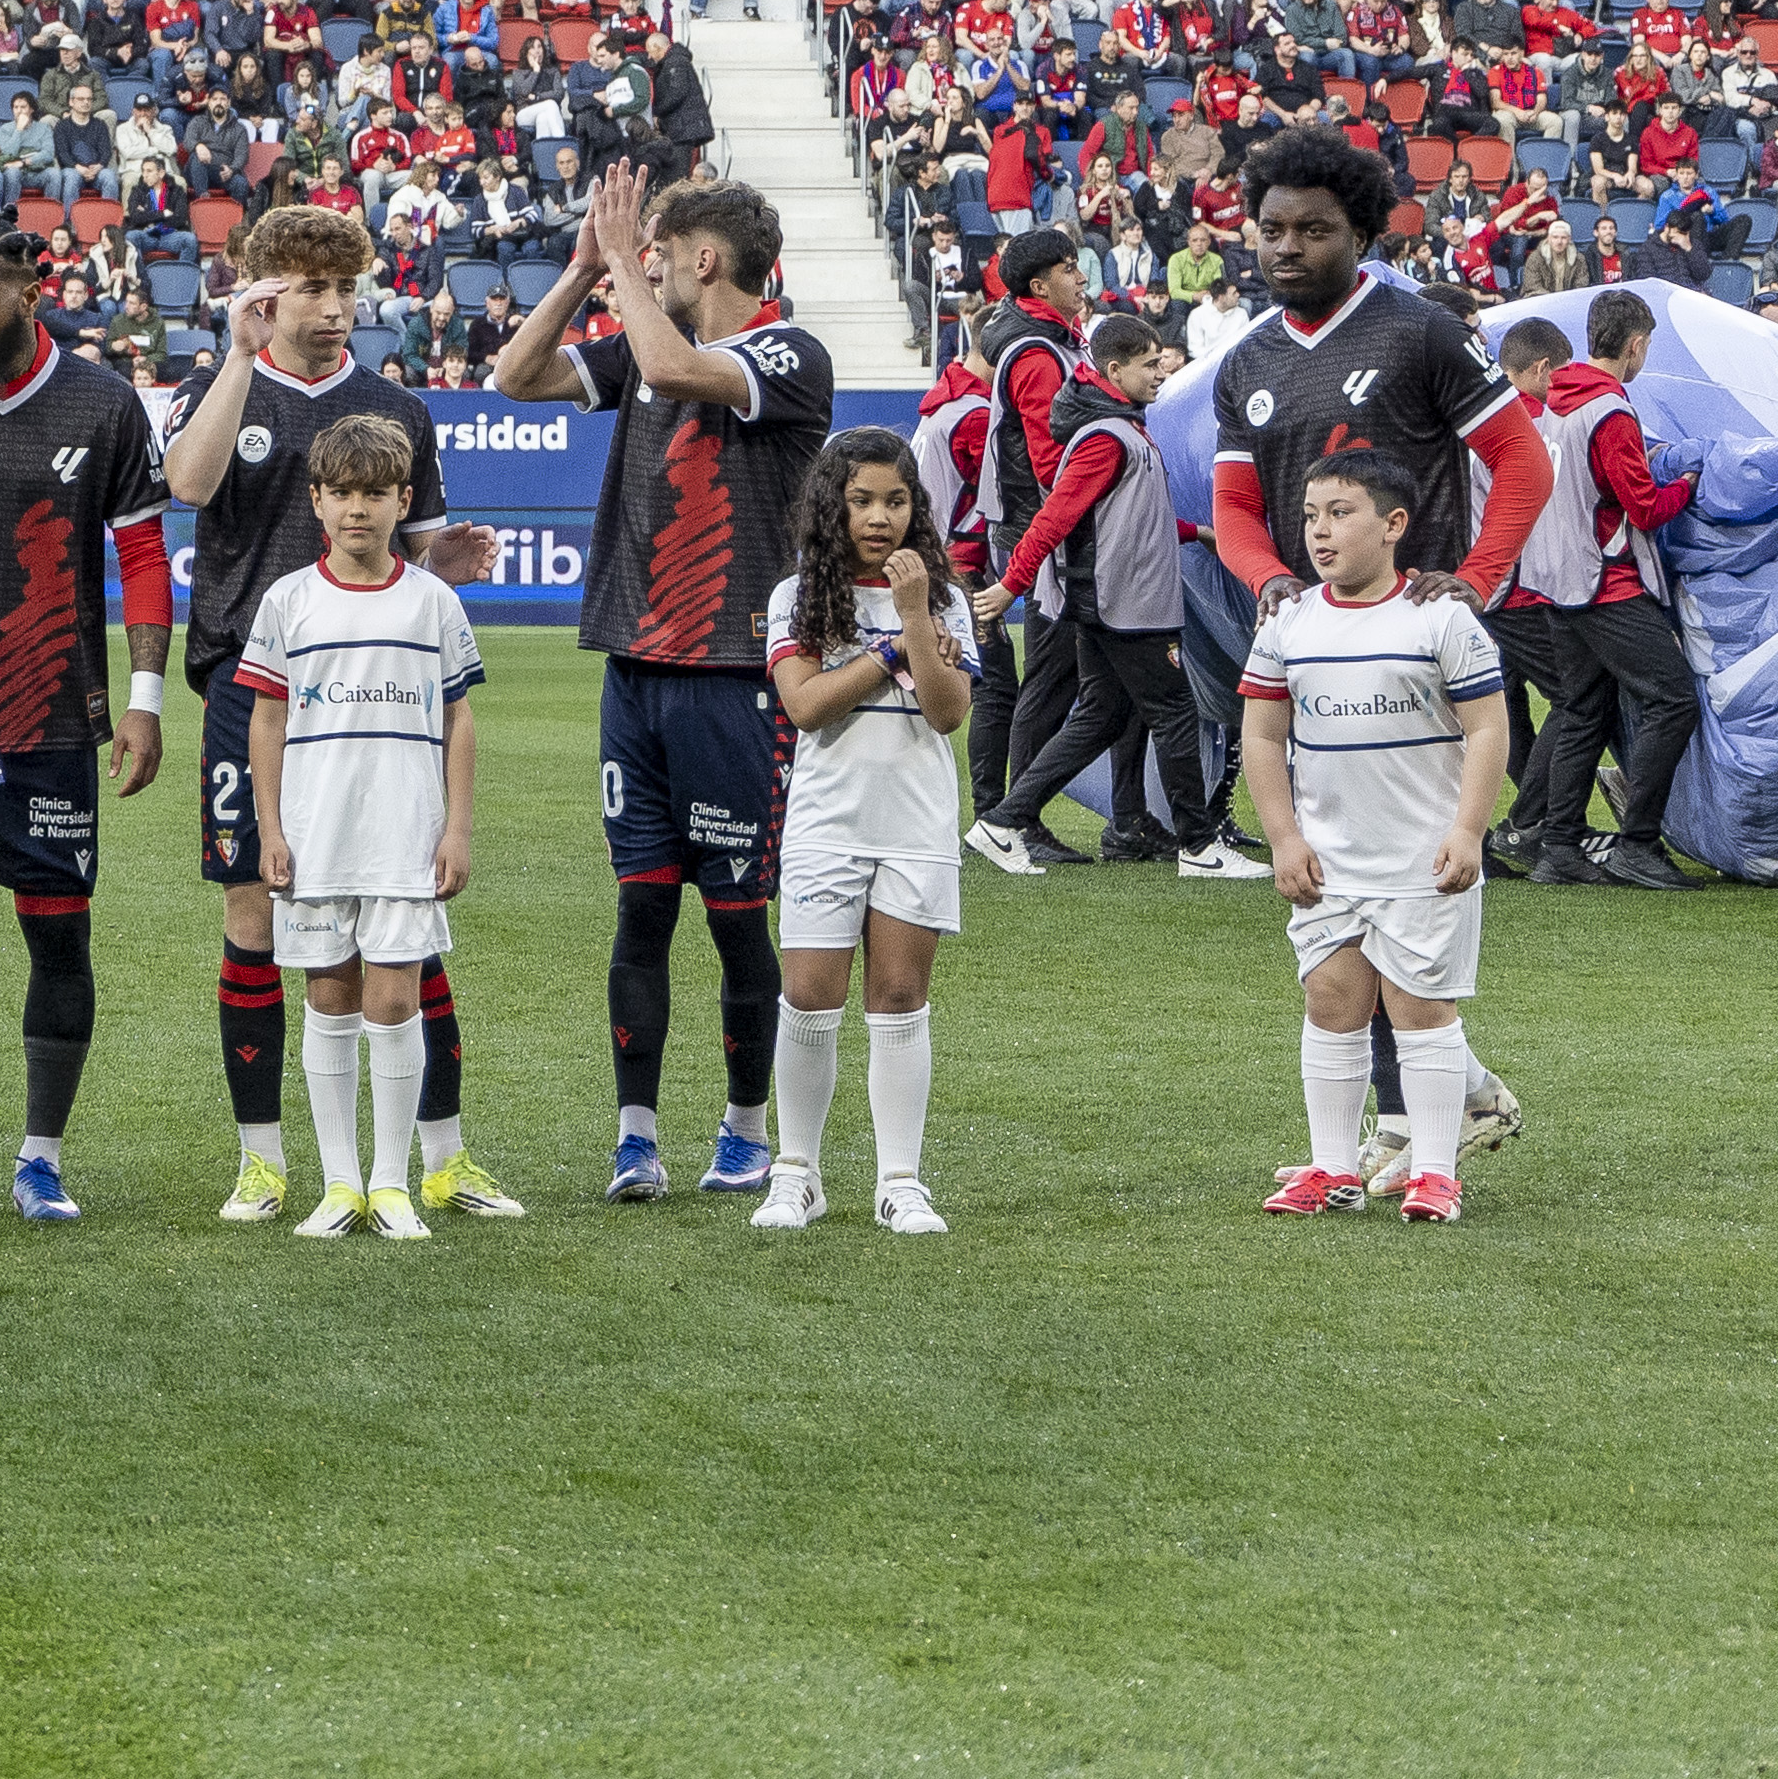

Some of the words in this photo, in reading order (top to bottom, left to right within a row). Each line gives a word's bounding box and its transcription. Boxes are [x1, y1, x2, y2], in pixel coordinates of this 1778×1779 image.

[756, 335, 800, 375] VS
[1251, 398, 1268, 411] EA
[243, 433, 266, 446] EA
[436, 412, 568, 452] rsidad
[328, 682, 423, 707] CaixaBank
[1314, 694, 1424, 717] CaixaBank
[29, 796, 72, 811] Clínica
[690, 802, 731, 819] Clínica
[29, 809, 93, 826] Universidad
[689, 815, 758, 835] Universidad
[29, 825, 44, 837] de
[47, 826, 92, 838] Navarra
[689, 829, 704, 841] de
[705, 831, 752, 848] Navarra
